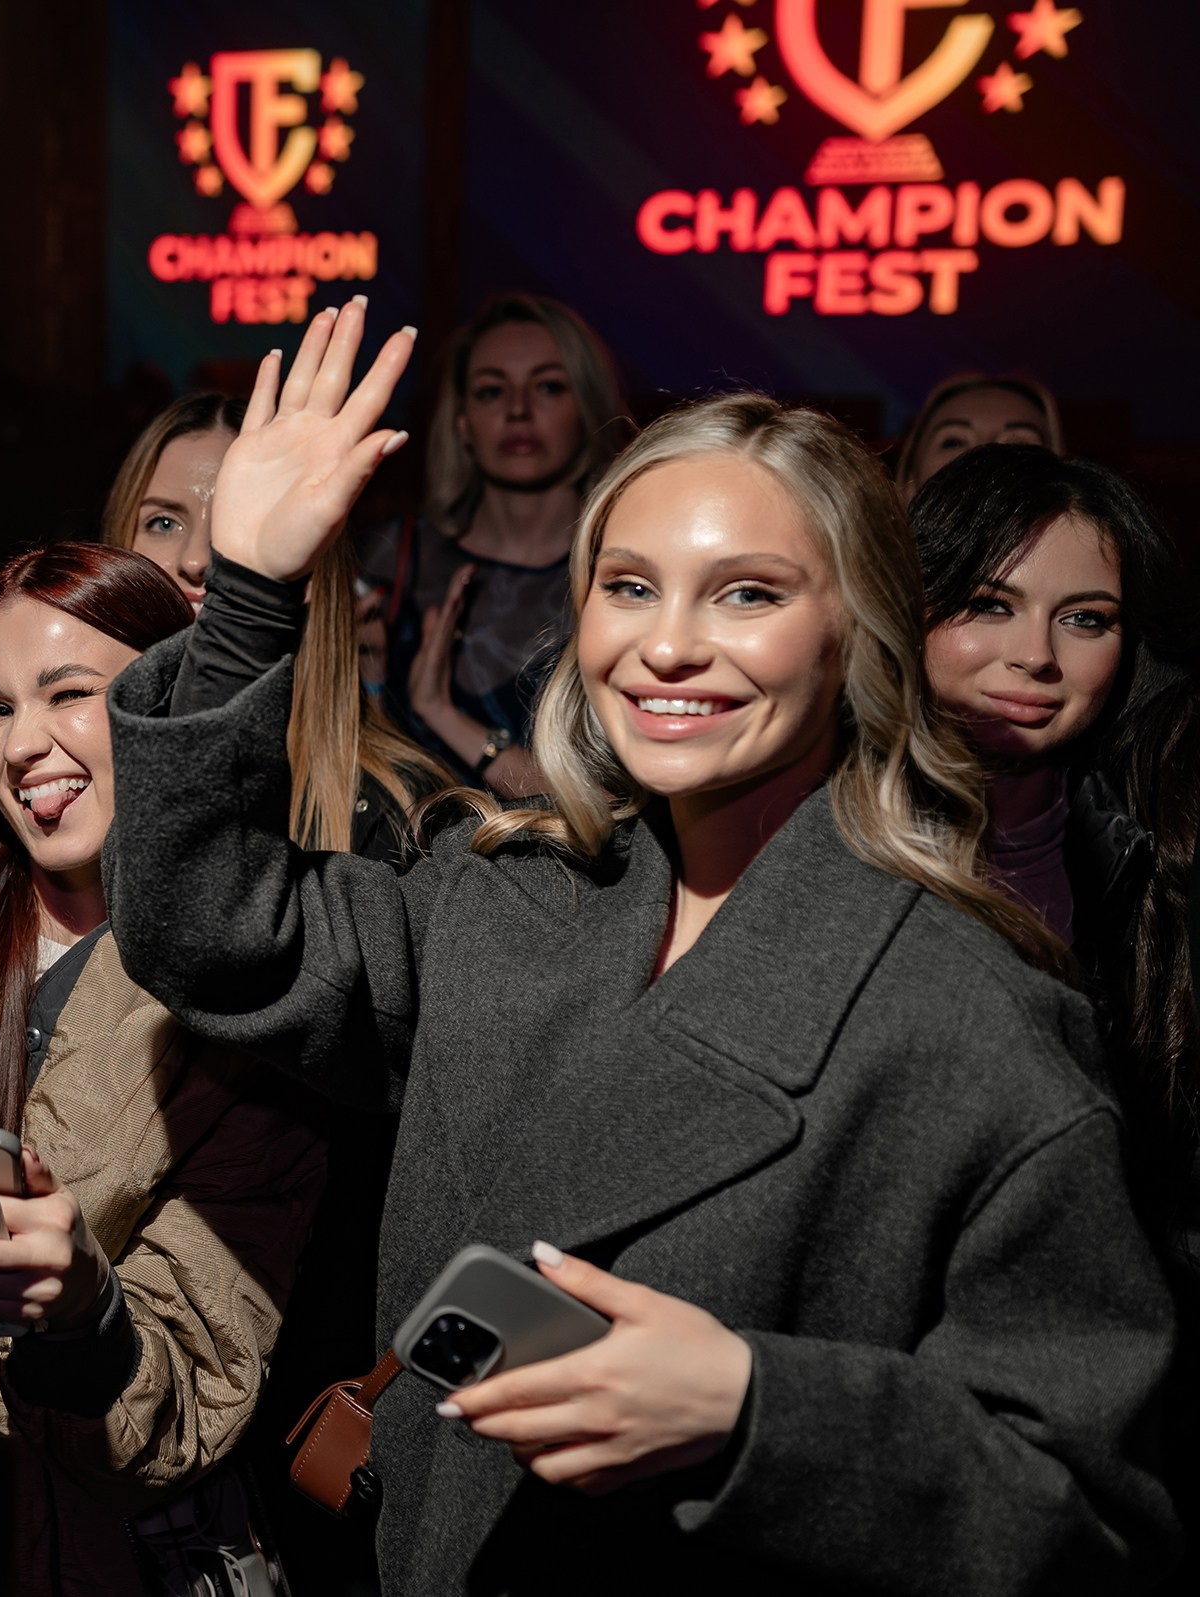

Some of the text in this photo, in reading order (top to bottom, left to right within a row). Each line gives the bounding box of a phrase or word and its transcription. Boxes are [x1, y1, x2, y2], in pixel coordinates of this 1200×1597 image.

[636, 176, 1125, 254] CHAMPION
[148, 232, 377, 281] CHAMPION
[763, 248, 979, 316] FEST
[210, 277, 317, 324] FEST
